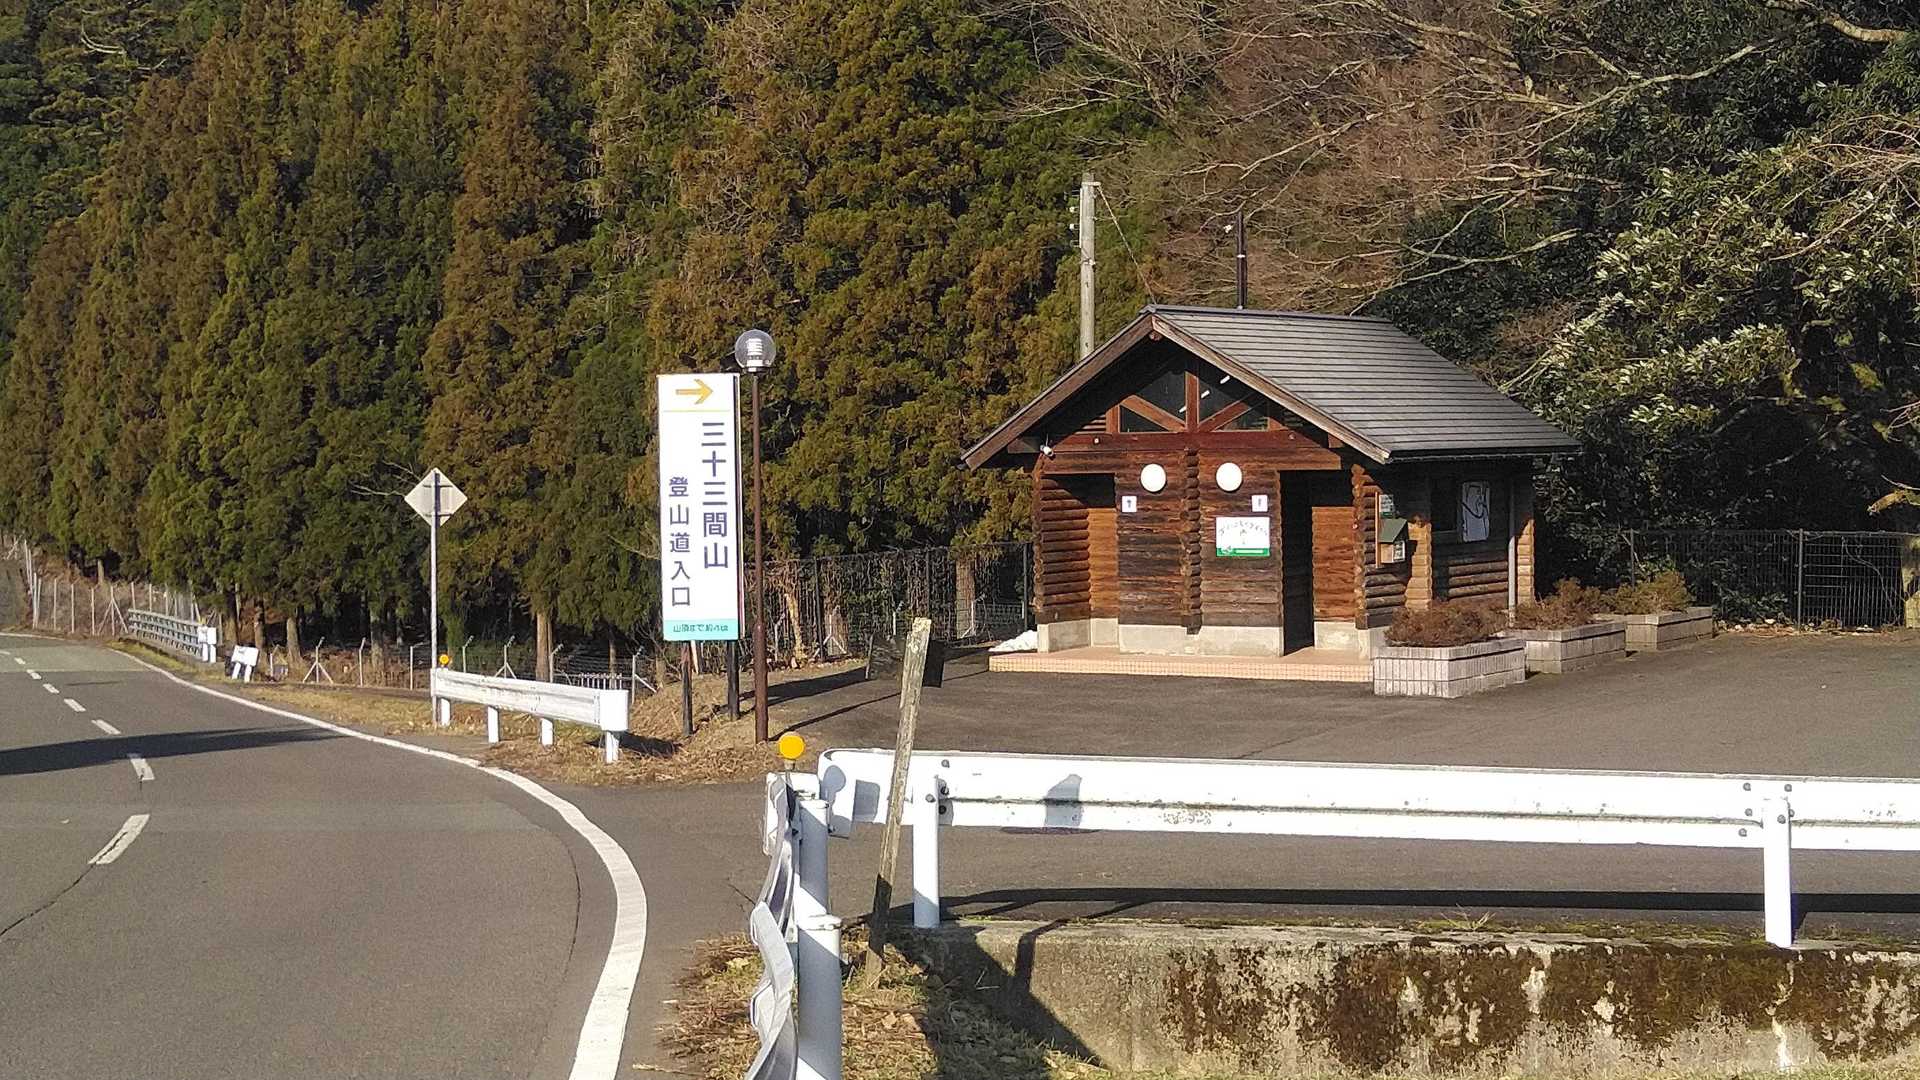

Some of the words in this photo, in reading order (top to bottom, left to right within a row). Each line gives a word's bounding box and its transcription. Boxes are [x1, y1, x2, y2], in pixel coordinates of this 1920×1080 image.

[669, 477, 691, 606] 登山道入口
[701, 422, 728, 569] 三十三間山
